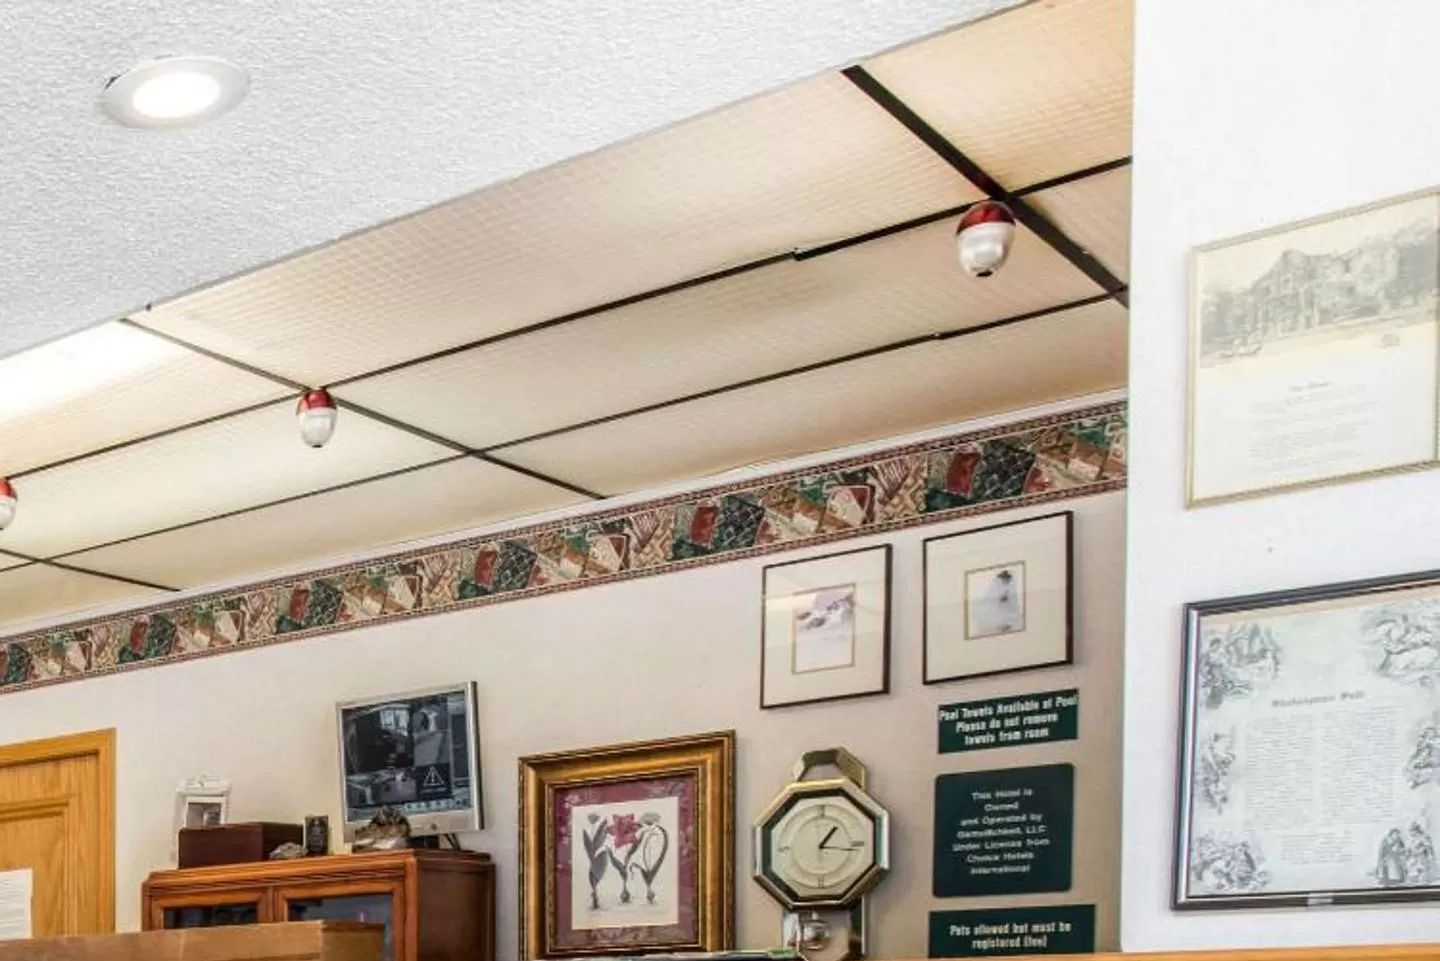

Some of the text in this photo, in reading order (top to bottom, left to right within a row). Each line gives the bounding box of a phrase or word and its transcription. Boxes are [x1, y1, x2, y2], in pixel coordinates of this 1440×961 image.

[962, 705, 993, 718] Towels
[997, 701, 1039, 714] Available
[956, 713, 1058, 732] Please do not remove
[999, 730, 1021, 742] from
[1025, 728, 1049, 738] room
[984, 801, 1019, 811] Owned
[982, 813, 1027, 825] Operated
[967, 854, 1000, 863] Choice
[949, 921, 1072, 936] Pets allowed but must be
[971, 936, 1021, 950] registered
